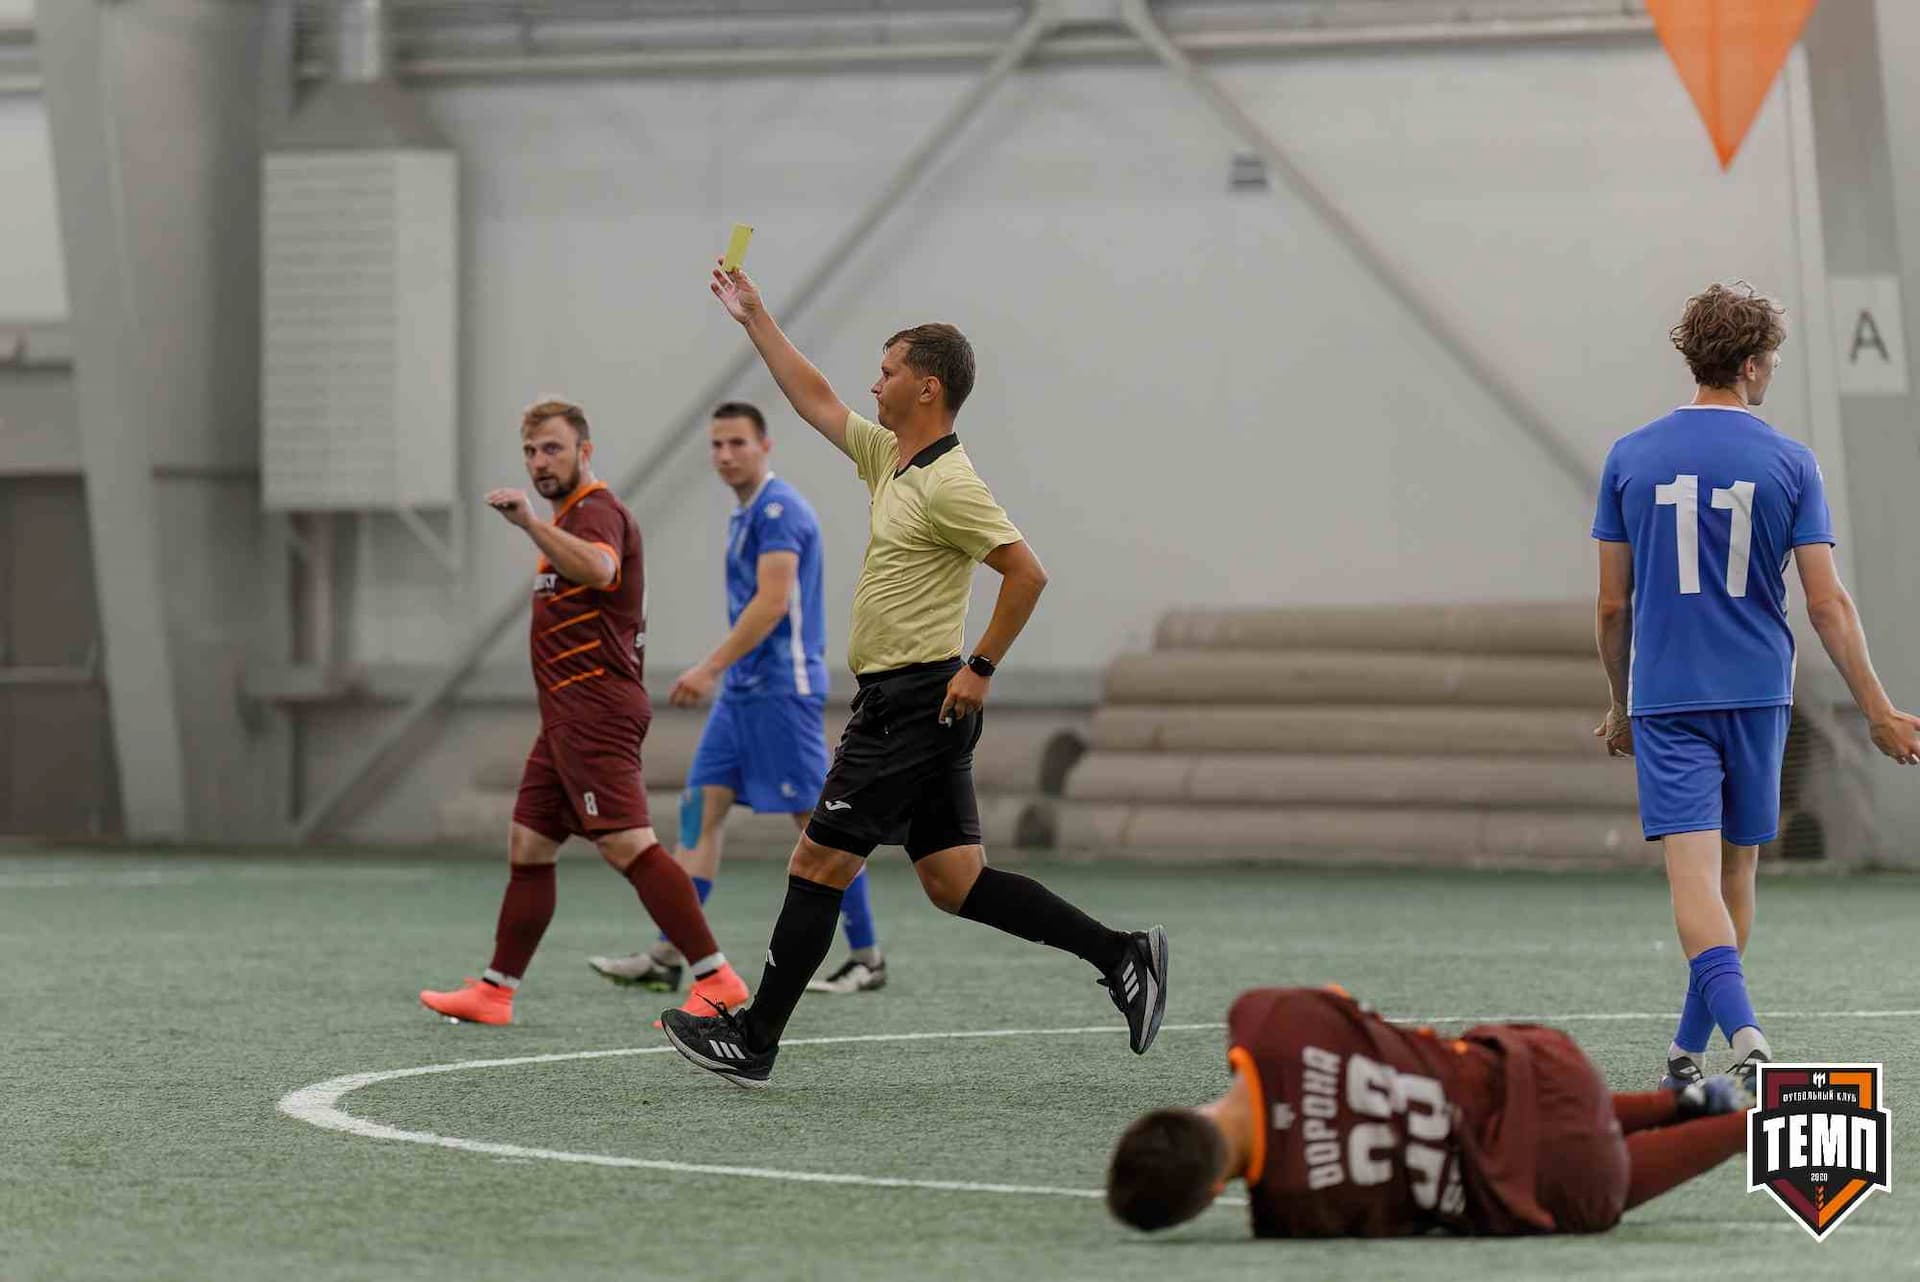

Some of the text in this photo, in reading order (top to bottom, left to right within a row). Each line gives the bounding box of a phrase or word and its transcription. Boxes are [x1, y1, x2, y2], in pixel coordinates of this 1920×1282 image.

[1655, 474, 1756, 598] 11
[583, 791, 599, 817] 8
[1302, 1046, 1344, 1190] ВОРОНА
